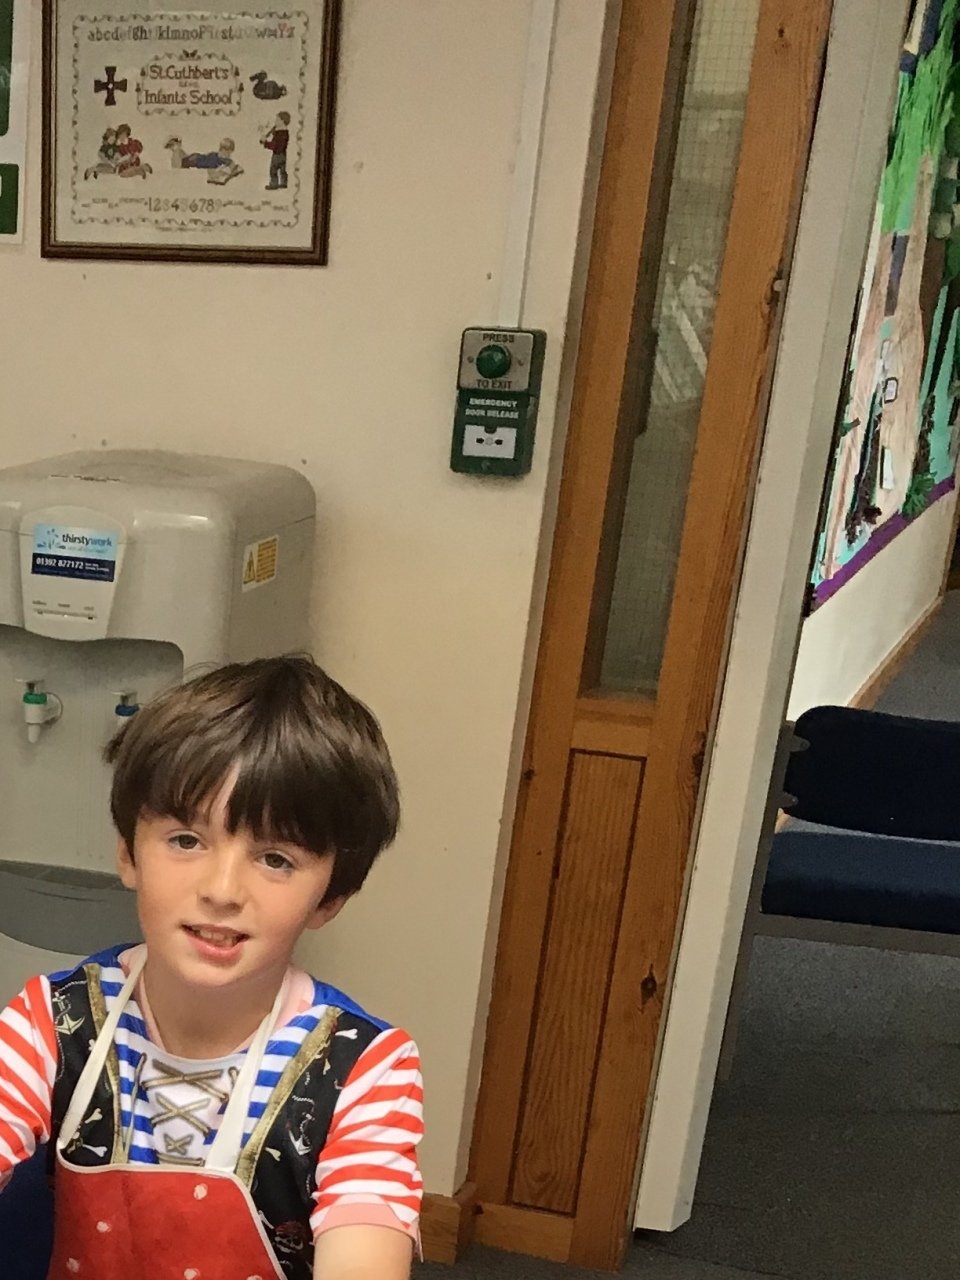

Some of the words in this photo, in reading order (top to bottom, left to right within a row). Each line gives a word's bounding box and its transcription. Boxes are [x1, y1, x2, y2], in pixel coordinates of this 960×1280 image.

[144, 88, 187, 105] Infants
[189, 88, 233, 105] School
[482, 333, 515, 343] PRESS
[476, 379, 489, 388] TO
[491, 380, 512, 389] EXIT
[469, 398, 518, 407] EMERGENCY
